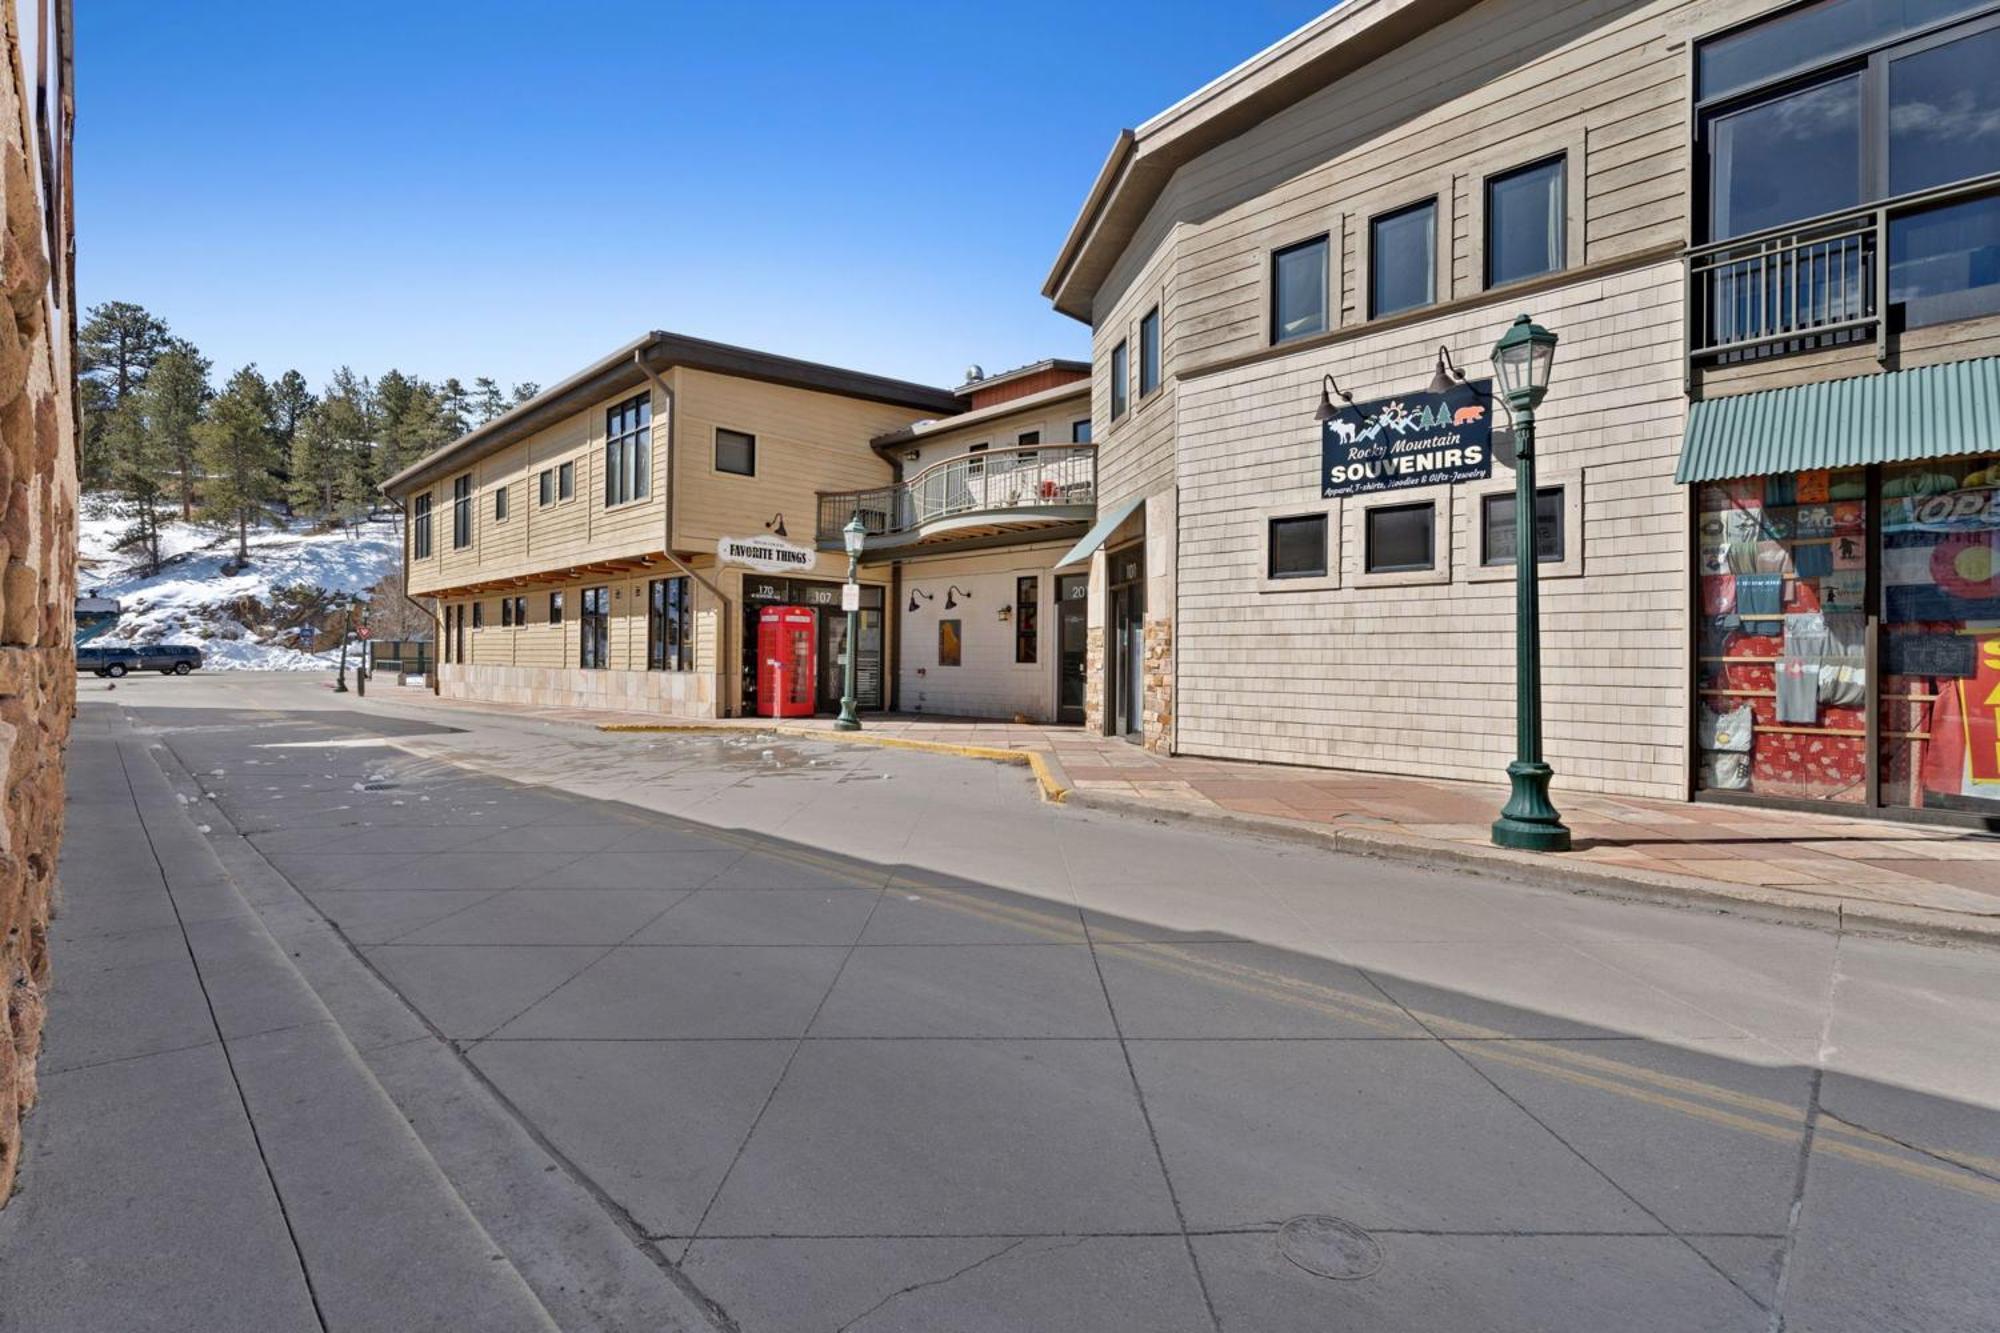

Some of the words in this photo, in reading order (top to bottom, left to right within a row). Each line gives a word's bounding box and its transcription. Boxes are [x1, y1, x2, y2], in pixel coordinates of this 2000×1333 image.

[1348, 443, 1387, 460] Rocky
[1390, 432, 1460, 453] Mountain
[1330, 445, 1483, 484] SOUVENIRS
[729, 543, 774, 560] FAVORITE
[775, 549, 807, 564] THINGS
[814, 591, 832, 604] 107
